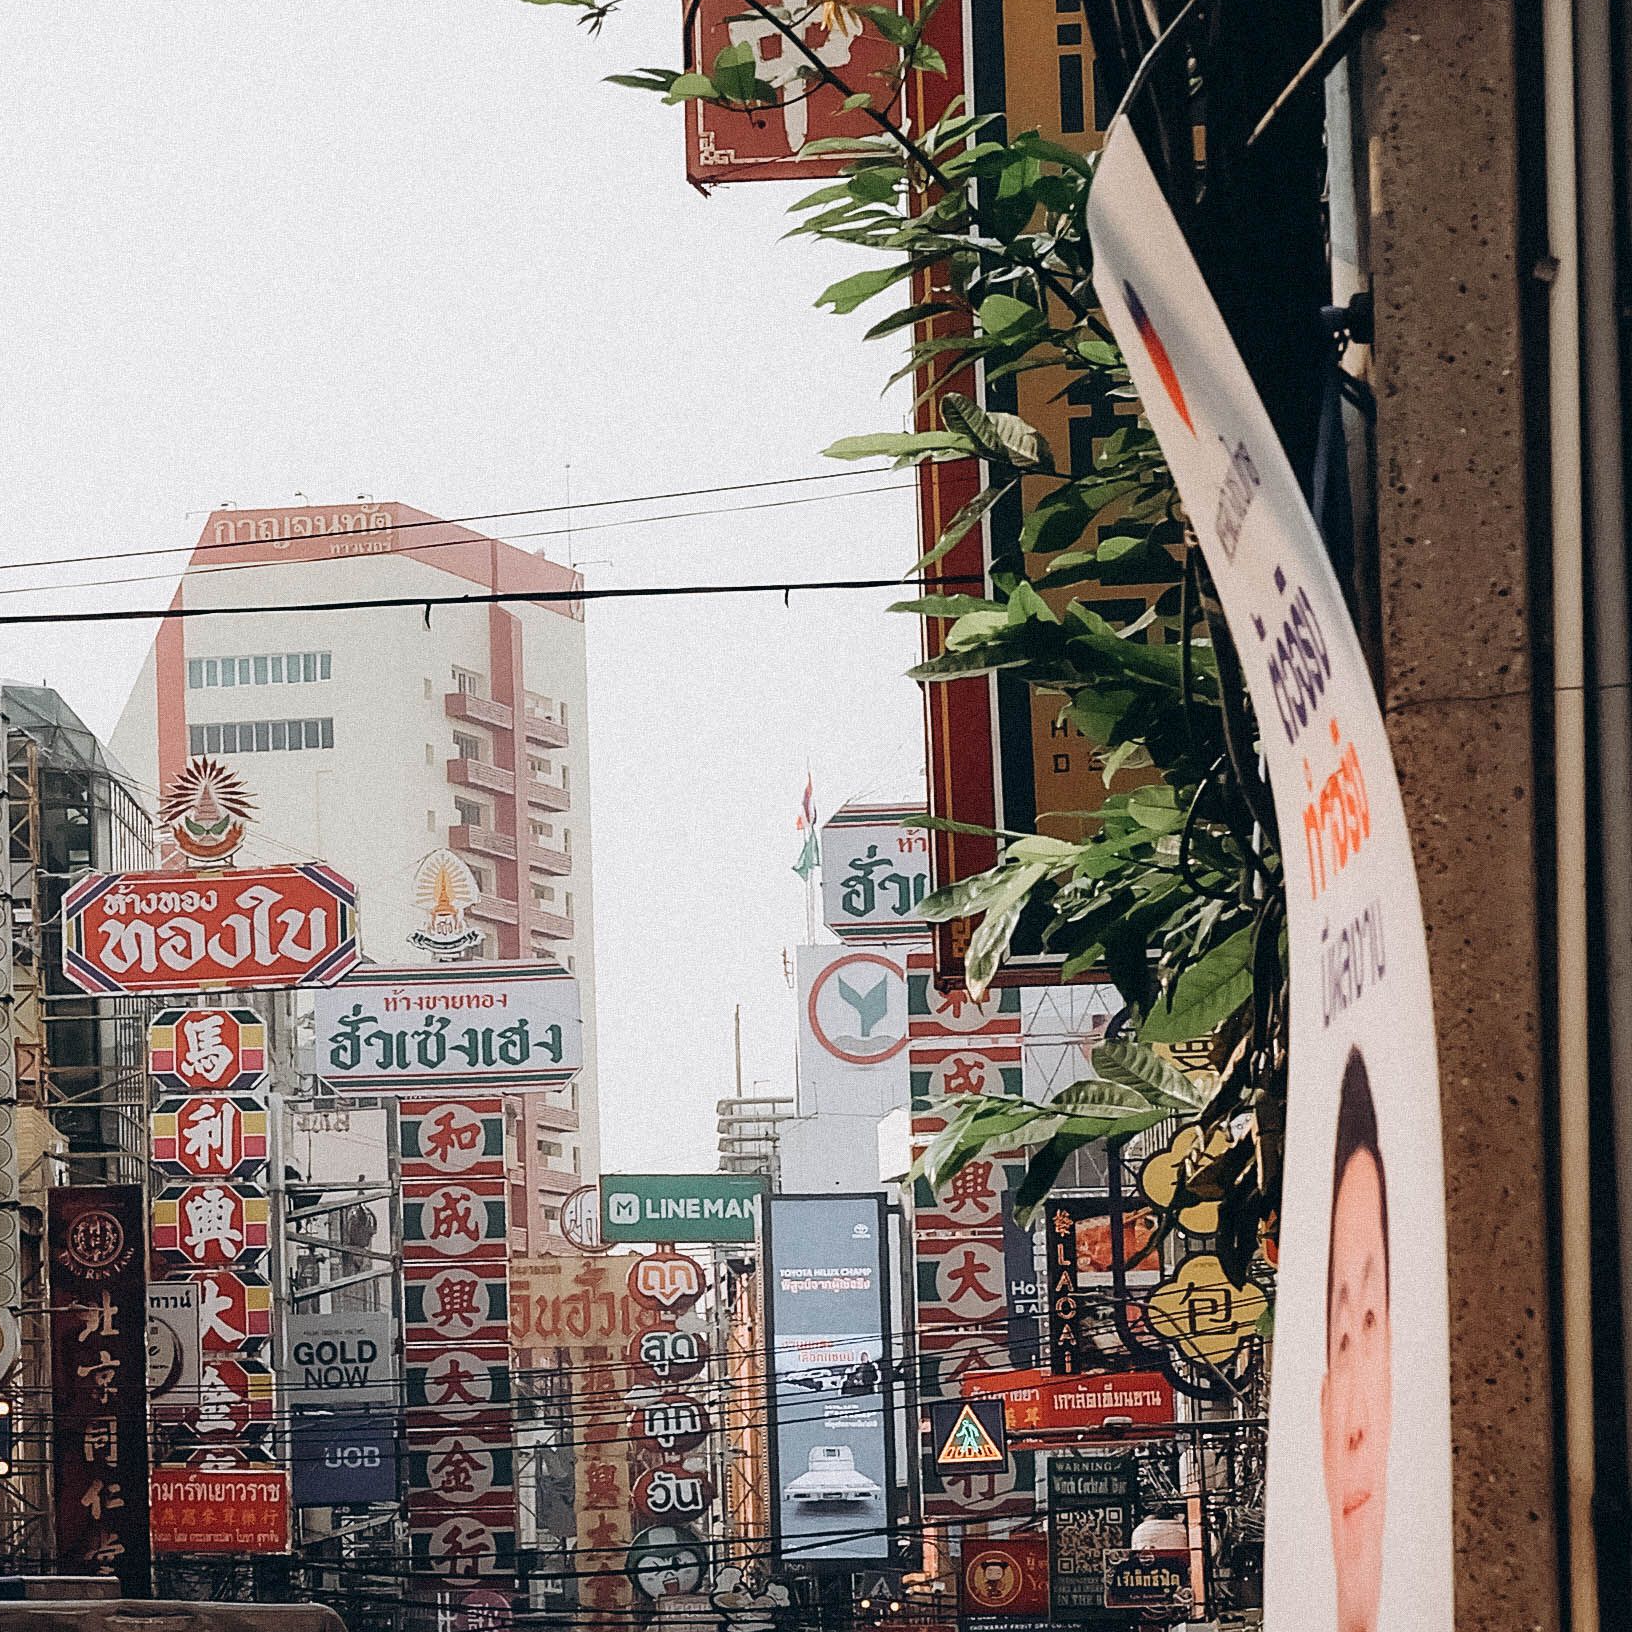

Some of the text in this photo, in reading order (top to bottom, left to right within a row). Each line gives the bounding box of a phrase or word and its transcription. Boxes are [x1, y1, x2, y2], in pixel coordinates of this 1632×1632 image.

[1258, 561, 1333, 748] ตัวจริง
[1302, 717, 1374, 903] ทำจริง
[102, 875, 219, 915] ห้างทอง
[97, 886, 327, 974] ทองใบ
[383, 990, 509, 1011] ห้างขายทอง
[329, 1006, 565, 1070] ฮั่วเซ่งเฮง
[646, 1198, 699, 1219] LINE
[1179, 1281, 1238, 1336] 包
[293, 1340, 378, 1366] GOLD
[424, 1110, 492, 1577] 和成興大金行
[304, 1366, 369, 1389] NOW
[324, 1446, 382, 1468] UOB
[648, 1473, 704, 1512] วัน
